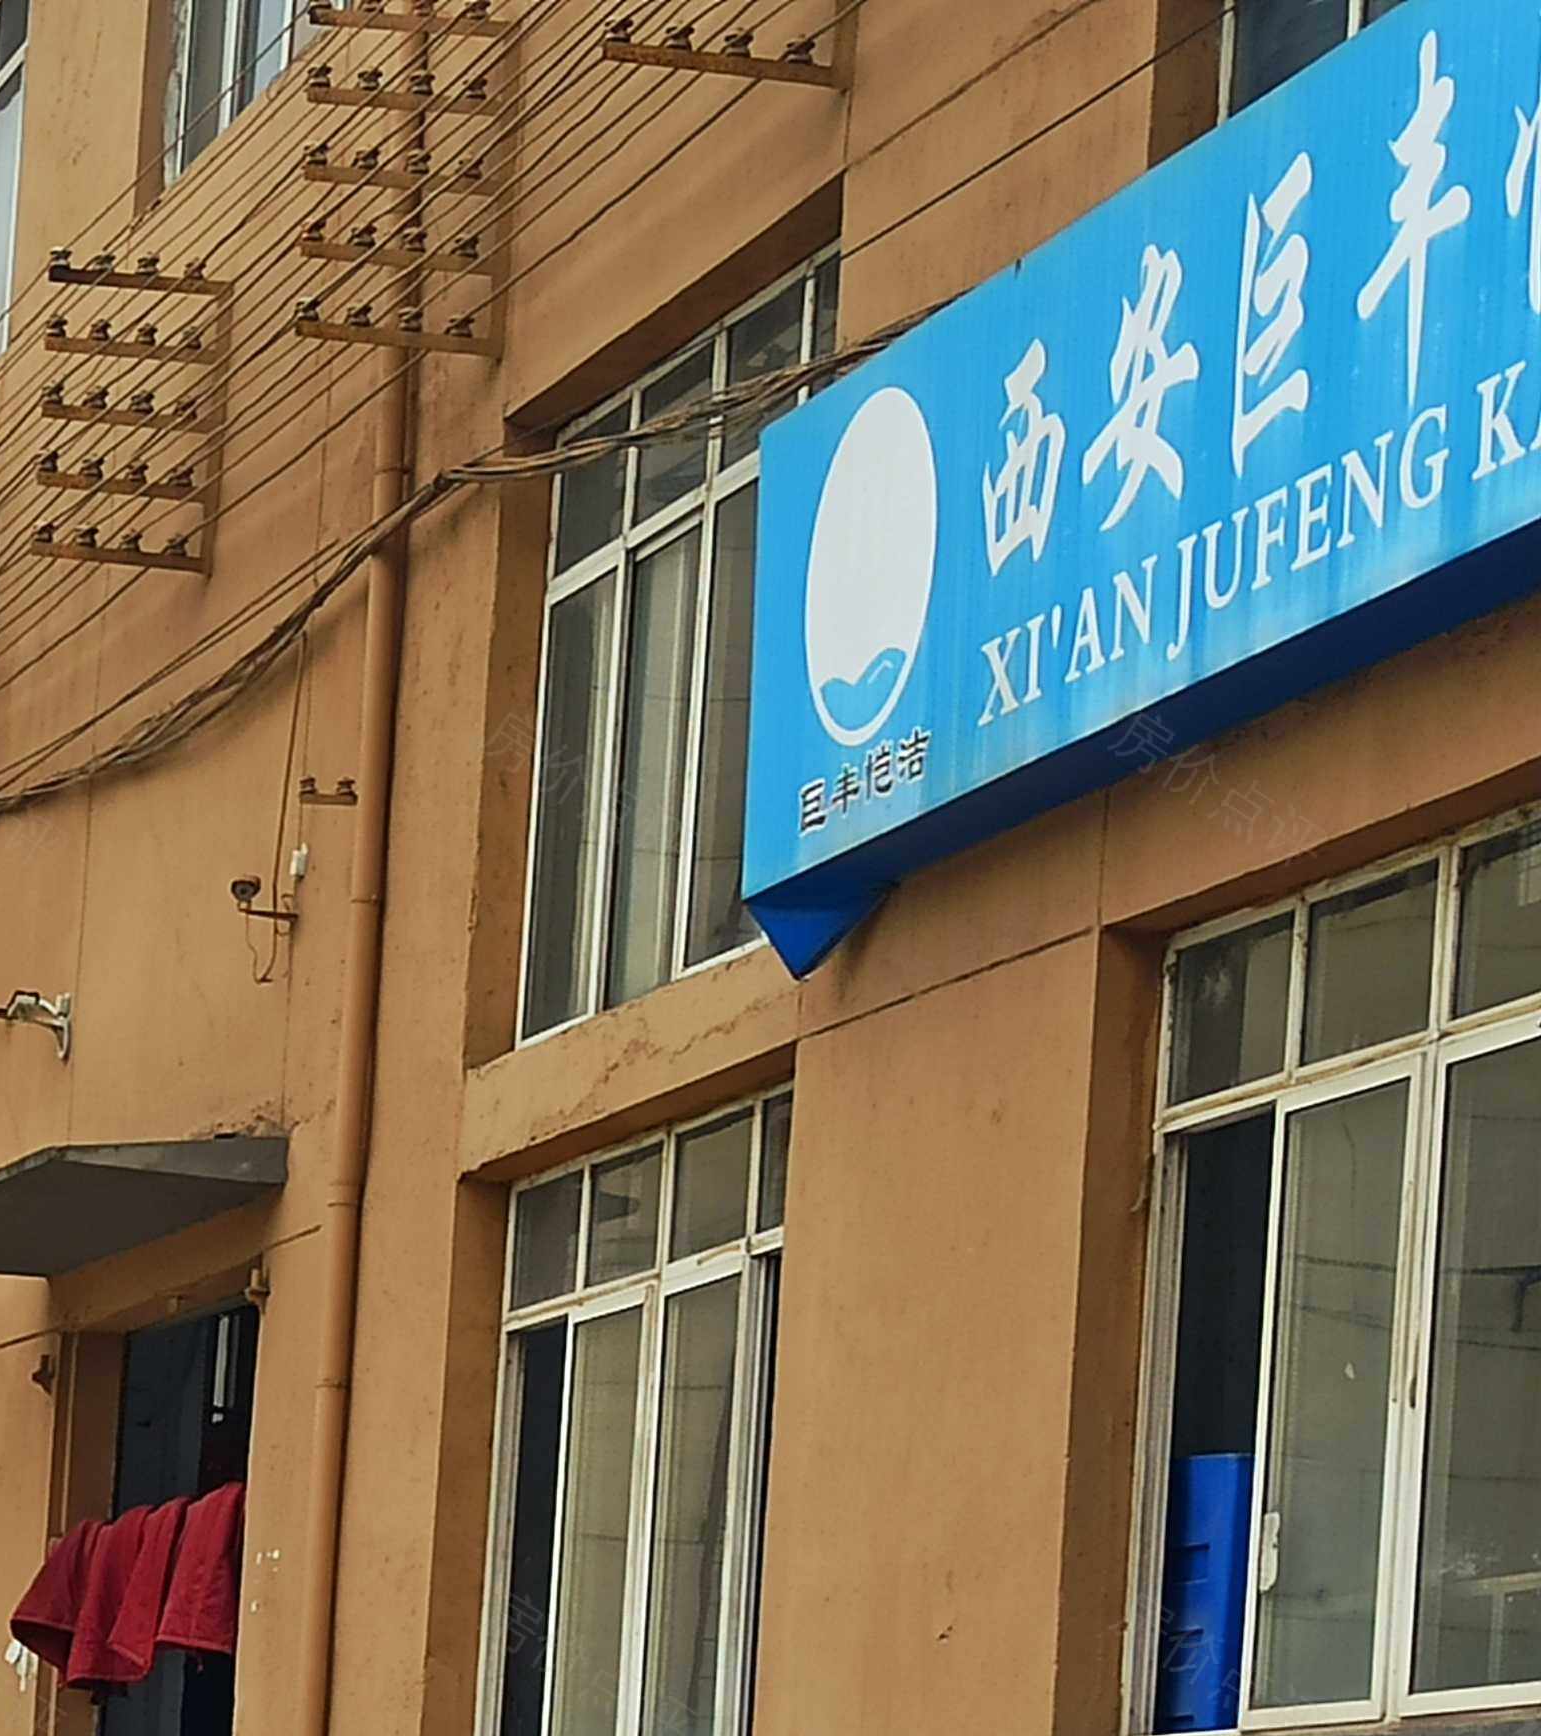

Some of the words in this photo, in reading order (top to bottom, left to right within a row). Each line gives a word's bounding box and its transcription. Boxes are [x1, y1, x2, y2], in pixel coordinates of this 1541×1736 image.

[977, 554, 1158, 727] XI'AN
[1167, 403, 1450, 662] JUFENG
[1471, 360, 1541, 482] K
